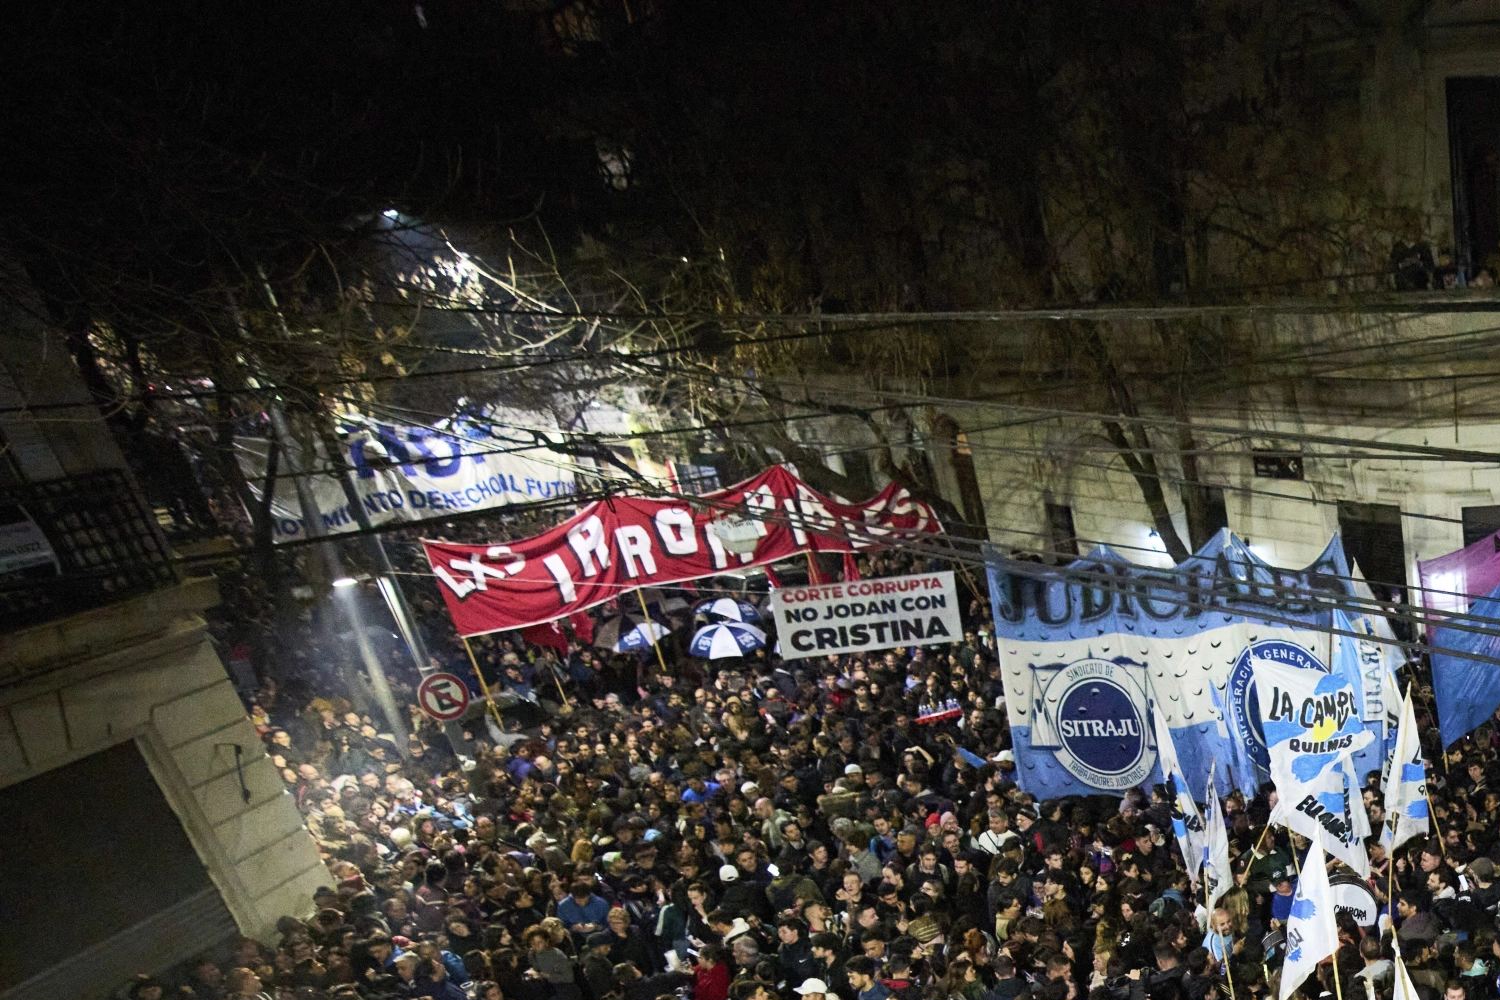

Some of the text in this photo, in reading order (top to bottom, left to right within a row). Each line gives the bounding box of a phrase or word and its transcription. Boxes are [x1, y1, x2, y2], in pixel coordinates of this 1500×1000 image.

[781, 577, 944, 604] CORTE CORRUPTA
[784, 594, 947, 624] NO JODAN CON
[790, 616, 951, 652] CRISTINA
[1066, 662, 1114, 682] SINDICATO DE
[1263, 648, 1320, 672] GENERA
[1269, 687, 1295, 723] LA
[1061, 718, 1140, 738] SITRAJU
[1289, 734, 1353, 755] QUILMES
[1068, 759, 1147, 788] TRABAJADORES JUDICIALES
